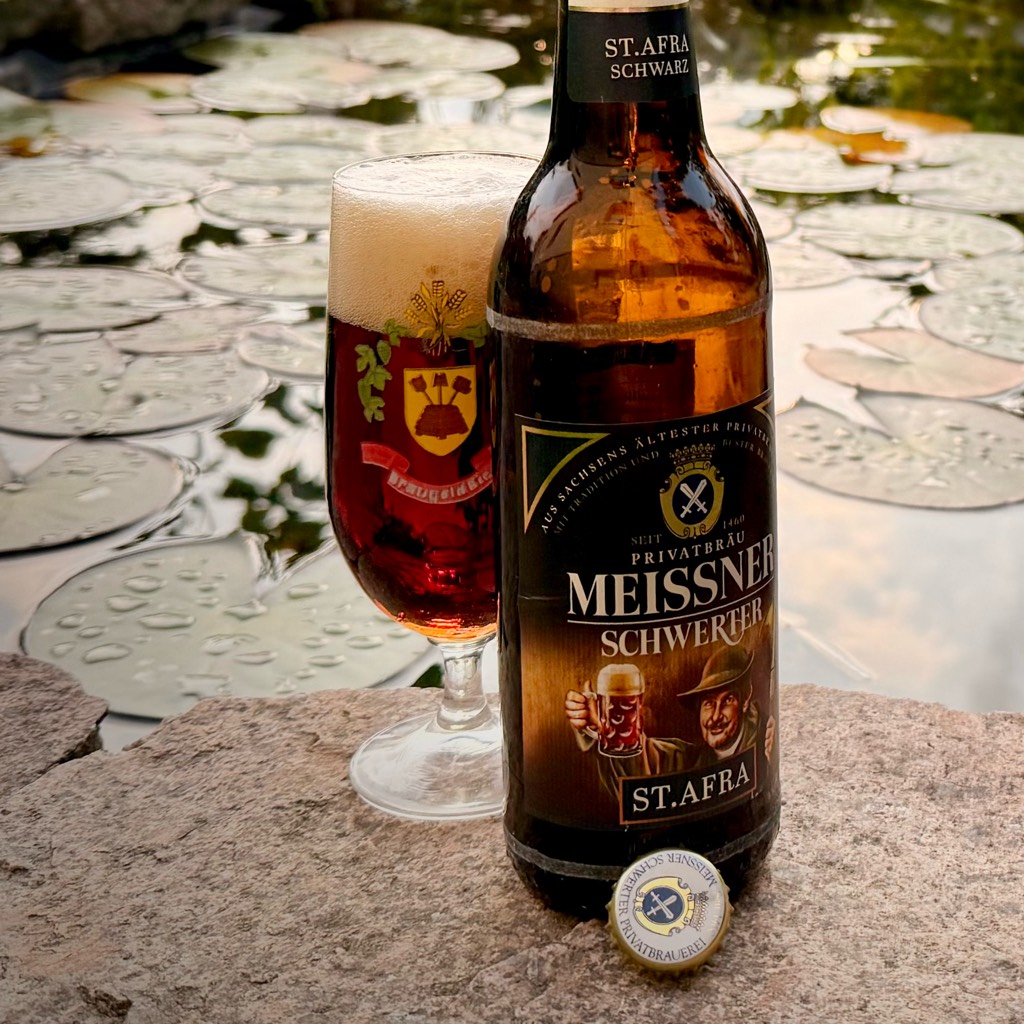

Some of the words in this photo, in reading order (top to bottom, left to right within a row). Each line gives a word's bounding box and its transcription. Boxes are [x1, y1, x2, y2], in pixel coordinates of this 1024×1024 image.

[605, 33, 690, 58] ST.AFRA
[611, 59, 690, 80] SCHWARZ
[541, 504, 558, 535] AUS
[557, 445, 628, 502] SACHSENS
[635, 422, 720, 449] ÄLTESTER
[567, 463, 628, 513] TRADITION
[630, 450, 660, 468] UND
[631, 533, 663, 546] SEIT
[722, 514, 745, 530] 1460
[631, 530, 746, 566] PRIVATBRÄU
[566, 532, 775, 617] MEISSNER
[601, 596, 763, 657] SCHWERTER
[632, 761, 750, 813] ST.AFRA
[618, 854, 664, 917] SCHWERTER
[667, 852, 718, 888] MEISSNER
[620, 918, 707, 962] PRIVATBRAUEREI
